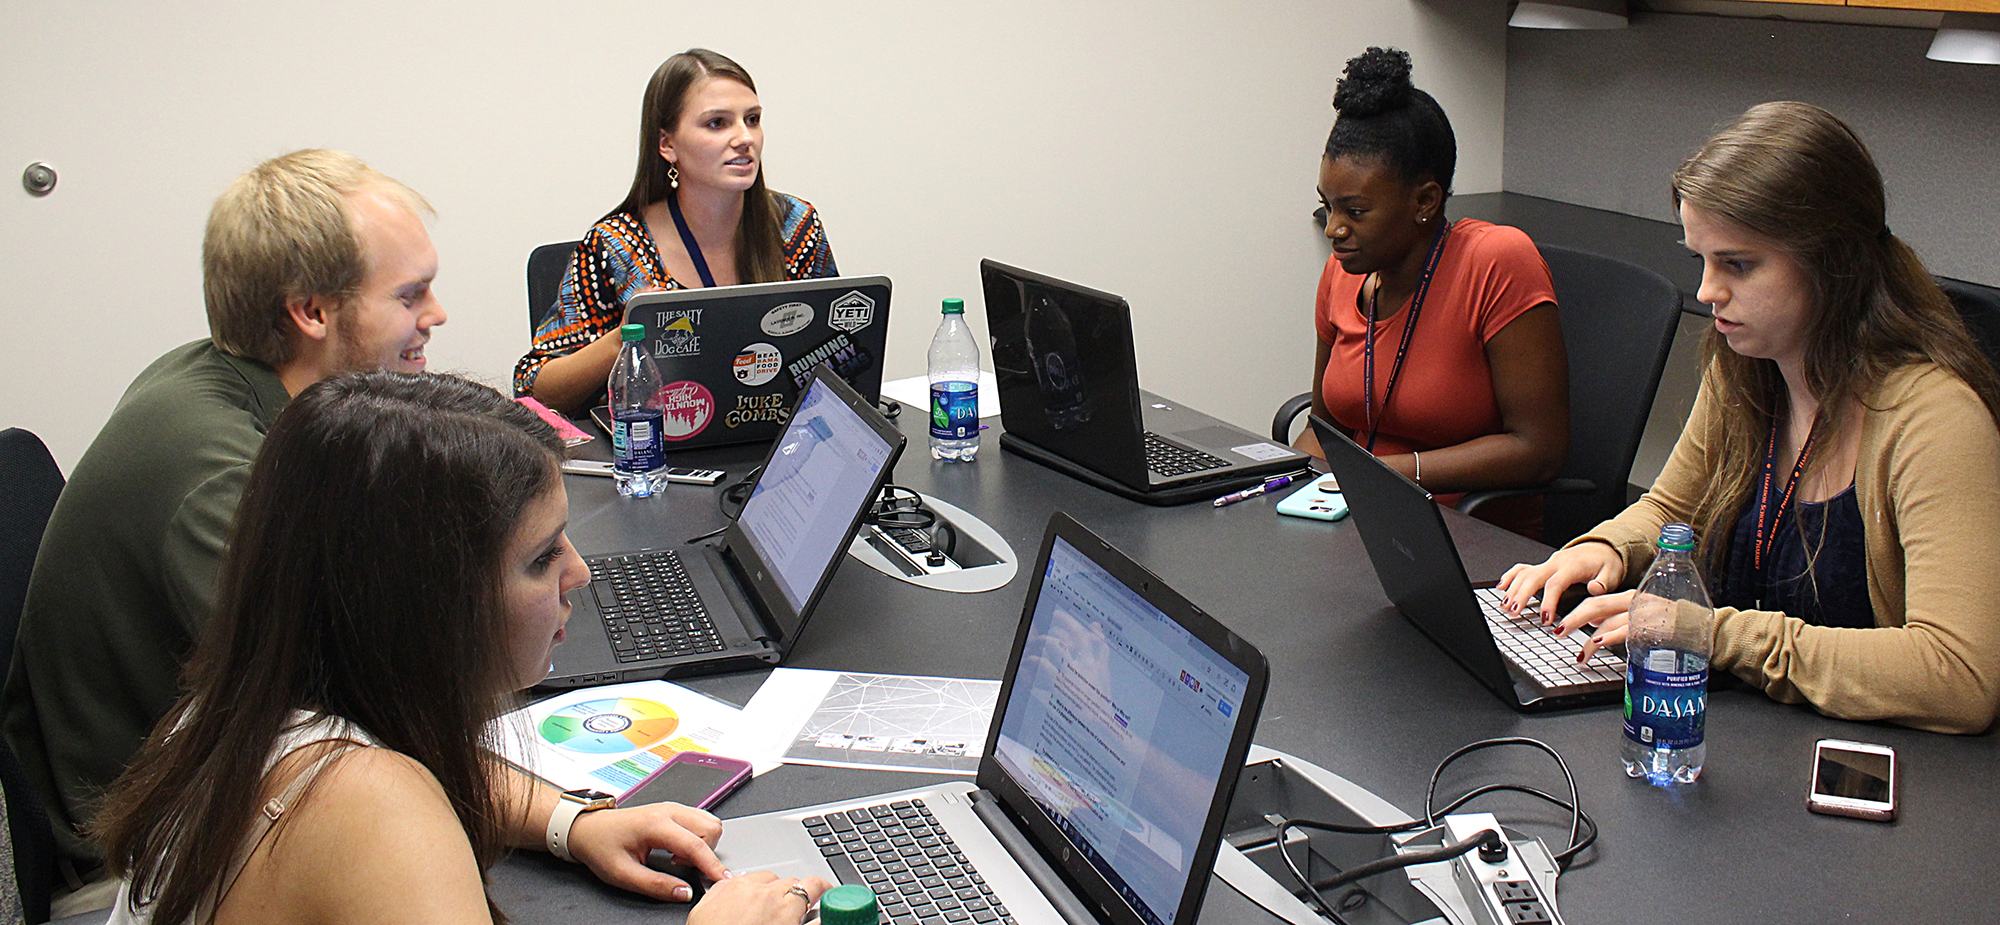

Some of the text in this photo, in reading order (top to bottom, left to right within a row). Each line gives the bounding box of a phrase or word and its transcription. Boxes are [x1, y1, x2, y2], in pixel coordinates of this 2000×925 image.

[656, 308, 703, 328] THE SALTY
[836, 308, 868, 318] YETI
[654, 339, 675, 356] DOG
[788, 333, 849, 377] RUNNING
[834, 343, 857, 364] MY
[665, 398, 706, 411] MOUNTA
[669, 394, 692, 404] HIGH
[736, 393, 783, 410] LUKE
[724, 407, 791, 429] COMBS
[1762, 473, 1771, 503] HARRISON
[1758, 504, 1767, 527] SCHOOL
[1755, 539, 1763, 569] PHARMACY
[1643, 694, 1706, 721] DASAN
